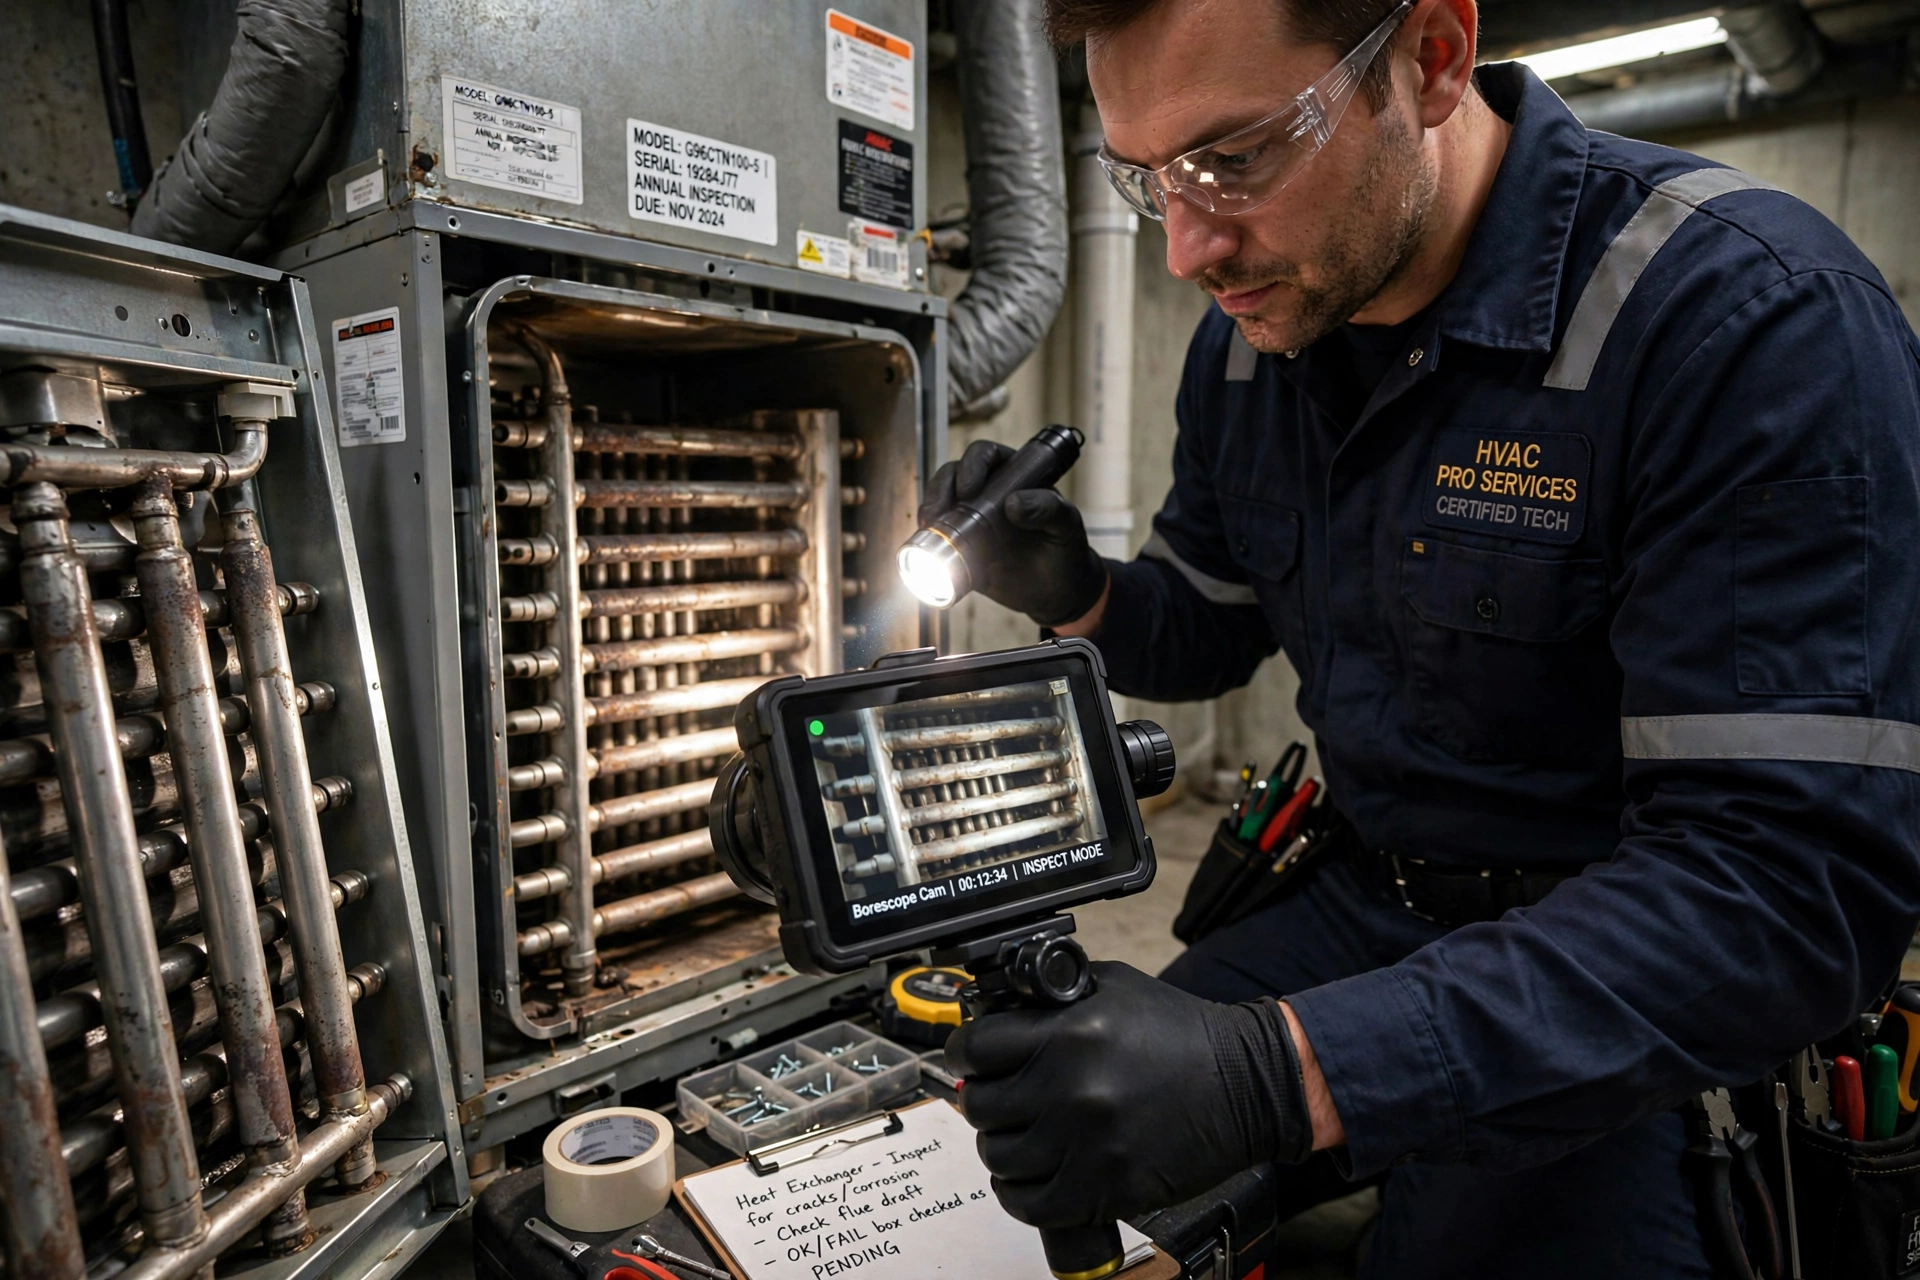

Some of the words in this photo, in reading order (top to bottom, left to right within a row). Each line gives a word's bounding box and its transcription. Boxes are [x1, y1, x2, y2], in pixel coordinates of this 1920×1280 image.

[634, 127, 682, 154] MODEL:
[634, 150, 682, 176] SERIAL:
[634, 172, 686, 198] ANNUAL
[689, 185, 755, 214] INSPECTION
[635, 194, 665, 216] DUE:
[669, 200, 695, 221] NOV
[698, 208, 725, 226] 2024
[1475, 439, 1541, 469] HVAC
[1435, 464, 1476, 490] PRO
[1479, 469, 1577, 503] SERVICES
[1436, 495, 1518, 524] CERTIFIED
[1522, 506, 1570, 532] TECH
[851, 892, 917, 919] Borescope
[919, 885, 947, 901] Cam
[958, 867, 1009, 892] 00:12:34
[1022, 851, 1068, 876] INSPECT
[1070, 843, 1104, 864] MODE
[736, 1187, 777, 1210] Heat
[786, 1164, 864, 1193] Exchanger
[886, 1139, 942, 1165] Inspect
[747, 1211, 774, 1227] for
[777, 1216, 830, 1241] Check
[838, 1204, 874, 1221] flue
[881, 1184, 923, 1207] draft
[787, 1228, 868, 1262] OK/FAIL
[871, 1219, 903, 1233] box
[909, 1192, 965, 1222] checked
[970, 1189, 987, 1201] as
[811, 1240, 901, 1280] PENDING
